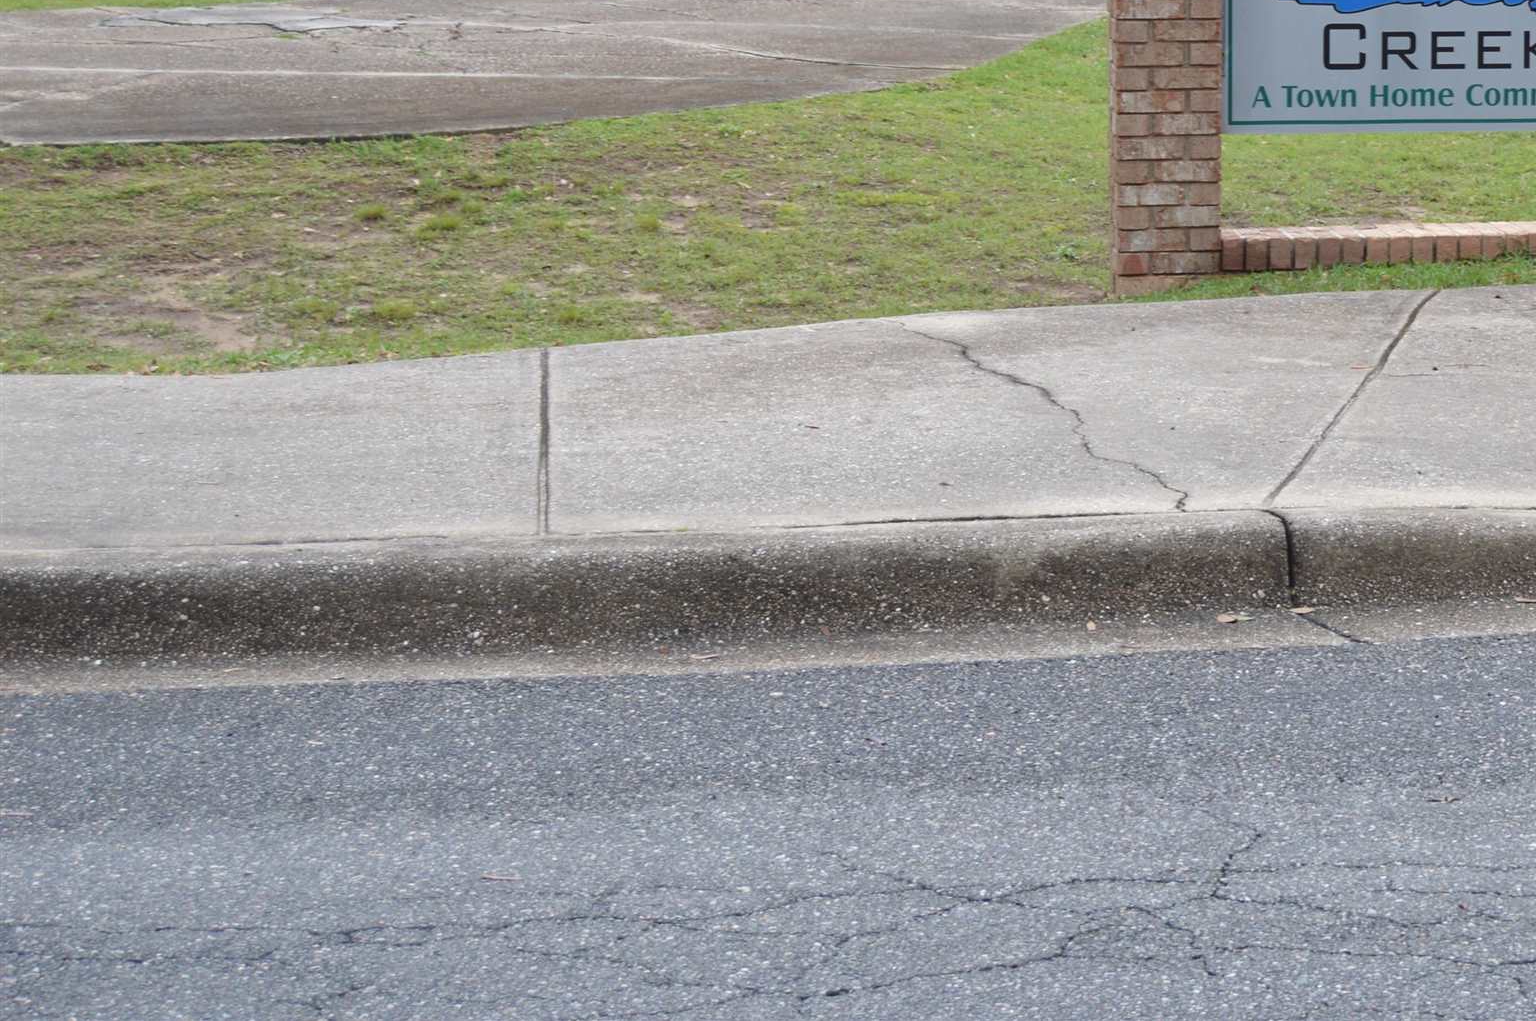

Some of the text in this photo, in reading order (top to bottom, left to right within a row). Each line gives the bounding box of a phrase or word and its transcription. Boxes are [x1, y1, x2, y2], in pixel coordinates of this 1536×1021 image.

[1251, 85, 1272, 108] A
[1281, 85, 1357, 108] Town
[1370, 85, 1455, 107] Home
